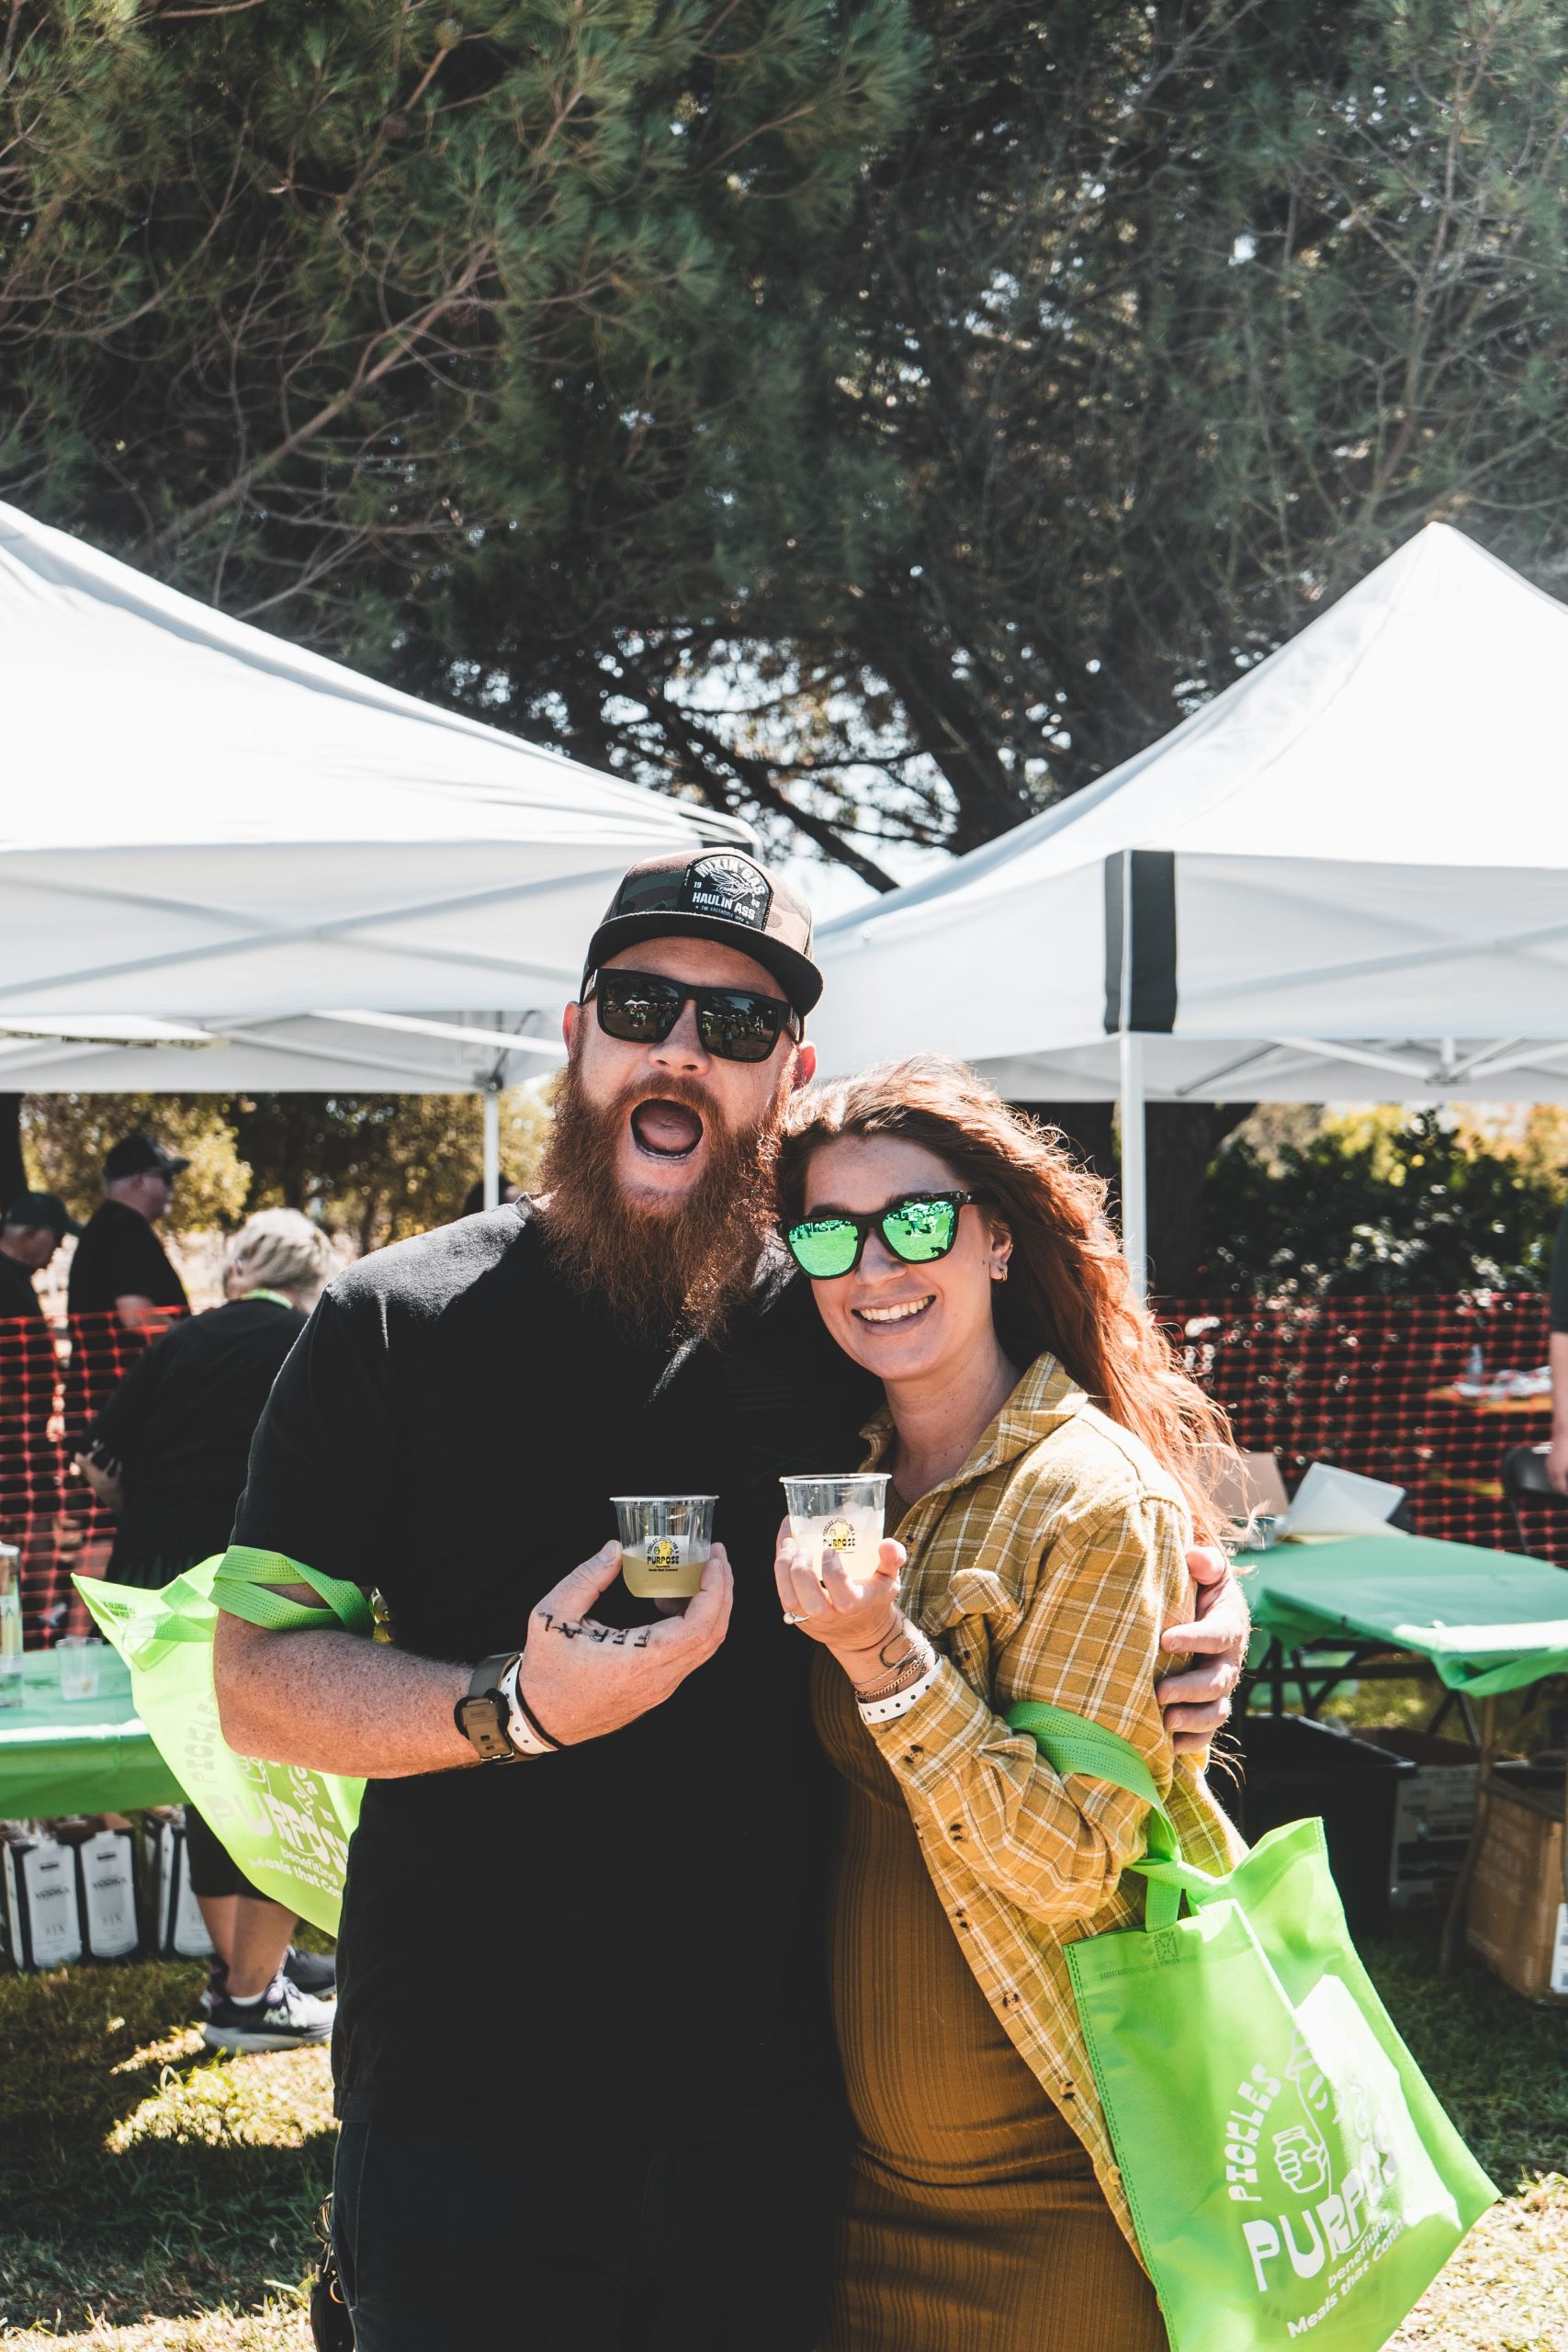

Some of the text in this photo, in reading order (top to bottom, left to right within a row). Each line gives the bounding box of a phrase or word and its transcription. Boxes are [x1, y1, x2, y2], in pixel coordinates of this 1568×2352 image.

[693, 892, 732, 910] HAULIN
[734, 902, 755, 921] ASS
[741, 868, 766, 895] GAS
[648, 1556, 679, 1565] PURPOSE
[823, 1538, 855, 1547] PURPOSE
[185, 1693, 220, 1783] PICKLE
[1224, 2063, 1281, 2201] PICKLES
[1328, 2212, 1389, 2289] benefiting
[1287, 2293, 1337, 2338] Meals
[1340, 2260, 1369, 2296] that
